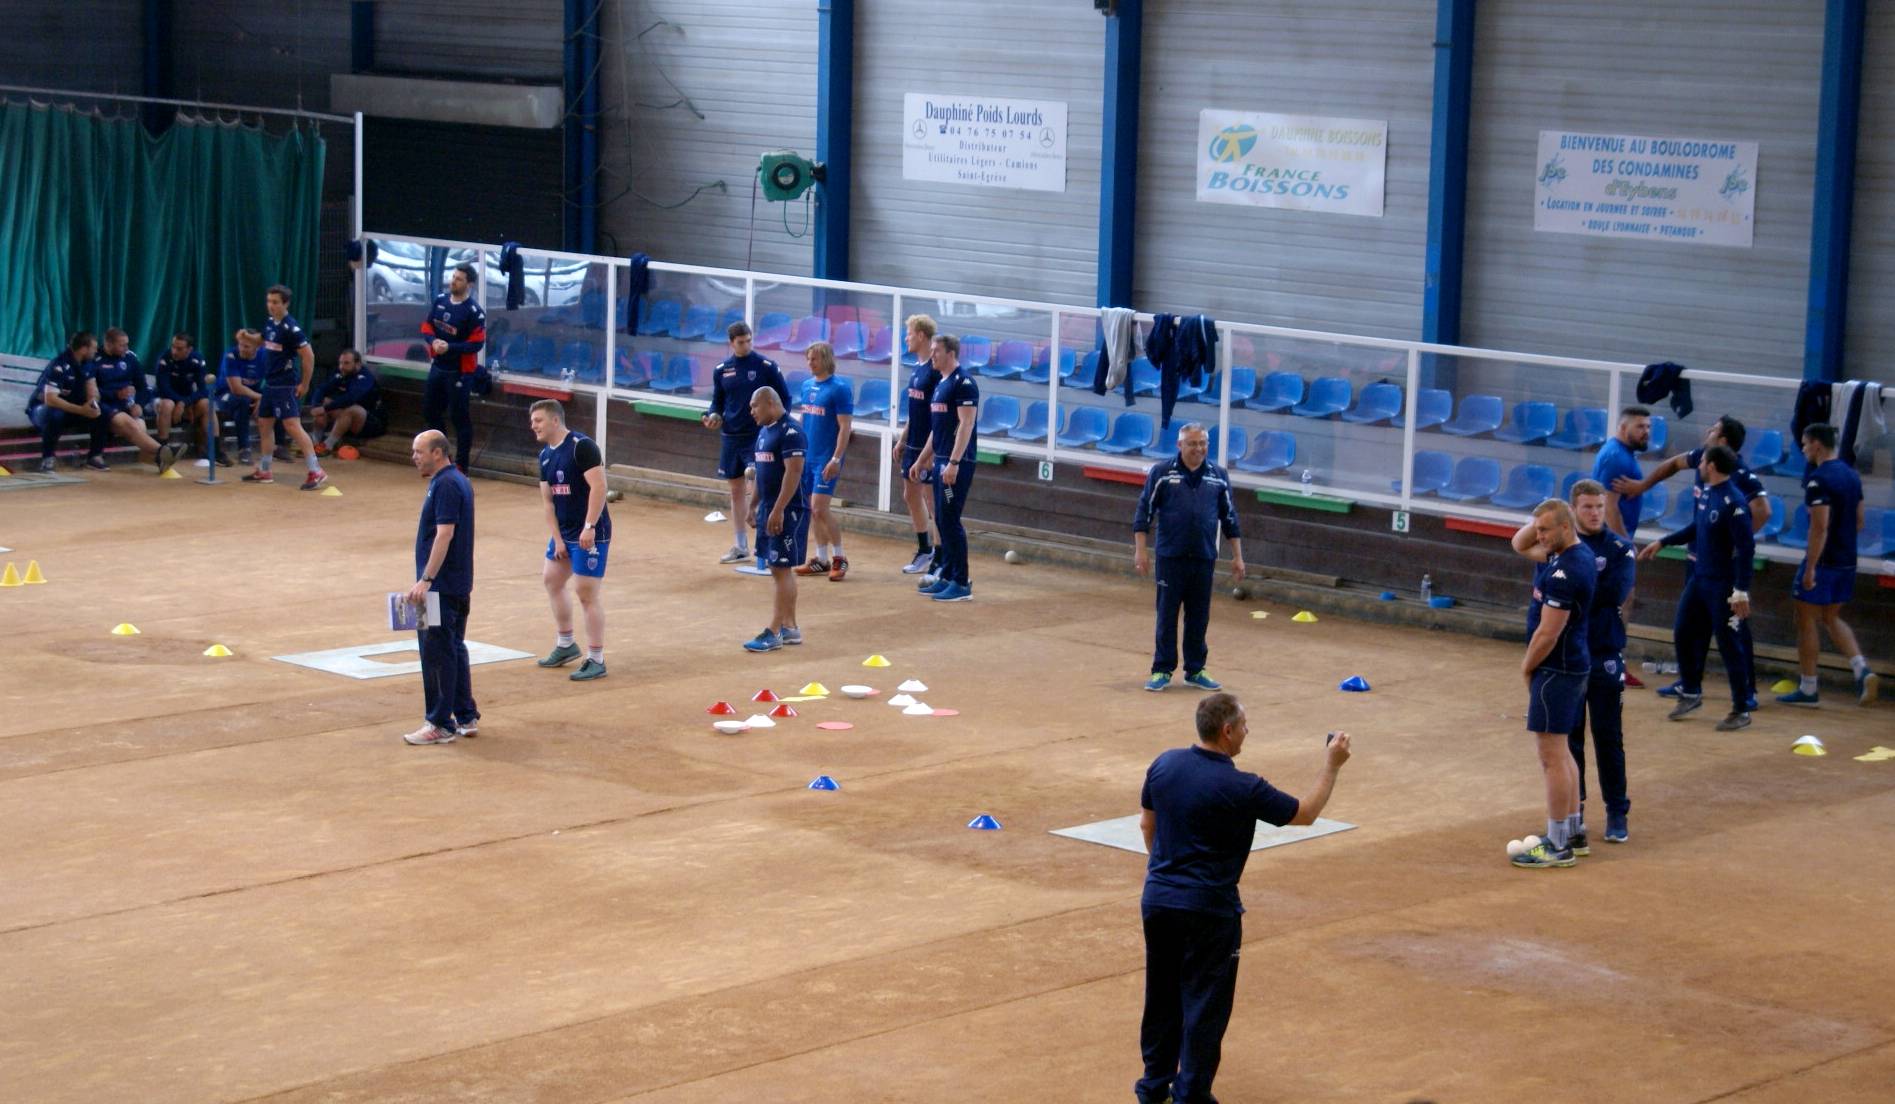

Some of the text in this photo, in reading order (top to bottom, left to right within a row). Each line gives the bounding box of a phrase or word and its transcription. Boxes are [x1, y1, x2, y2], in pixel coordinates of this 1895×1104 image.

[925, 101, 1043, 126] Dauphiné Poids Lourds
[959, 140, 1007, 153] Distributeur
[1327, 129, 1382, 147] BOISSONS
[1560, 135, 1736, 160] BIENVENUE AU BOULODROME
[928, 151, 968, 165] Utilitaires
[1005, 158, 1038, 170] Camions
[1592, 159, 1700, 180] DES CONDAMINES
[1243, 163, 1321, 182] FRANCE
[1208, 171, 1350, 200] BOISSONS
[1041, 463, 1050, 479] 6
[1397, 511, 1405, 529] 5
